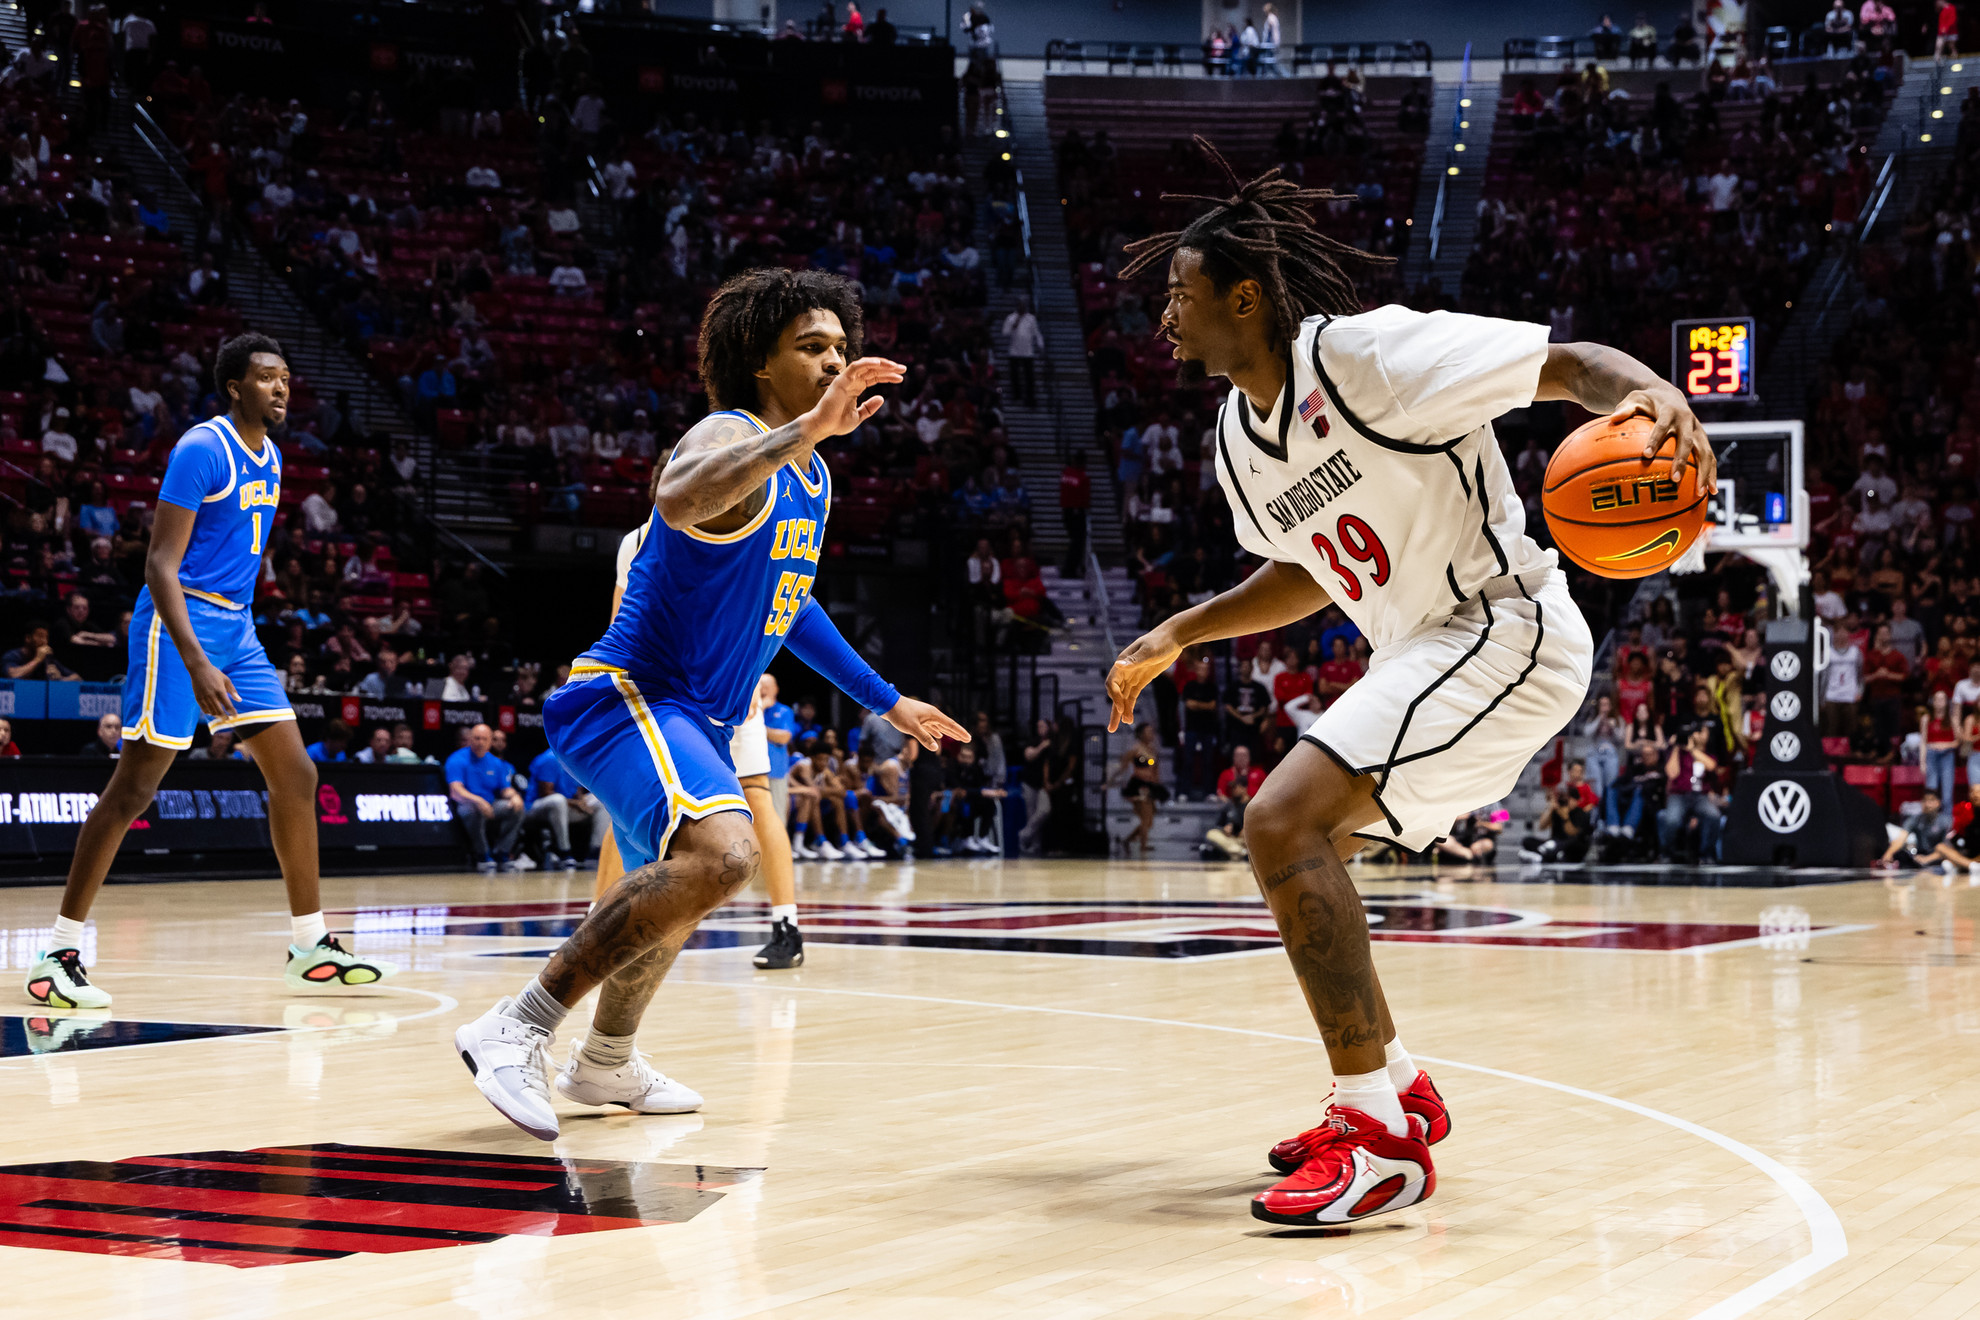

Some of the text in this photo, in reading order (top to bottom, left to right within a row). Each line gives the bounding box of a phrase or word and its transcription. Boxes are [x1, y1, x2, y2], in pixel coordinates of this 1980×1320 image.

[216, 31, 284, 52] TOYOTA
[405, 52, 475, 70] TOYOTA
[672, 74, 738, 92] TOYOTA
[855, 85, 922, 100] TOYOTA
[1690, 325, 1747, 351] 19:22
[1687, 350, 1741, 395] 23
[1266, 448, 1363, 533] SAN DIEGO STATE
[1590, 478, 1679, 512] ELITE
[250, 512, 262, 555] 1
[770, 518, 822, 566] UCL
[1311, 514, 1391, 601] 39
[764, 570, 815, 636] 55
[292, 703, 326, 719] YOTA
[364, 705, 407, 722] TOYOTA
[443, 709, 485, 725] TOYOTA
[517, 712, 544, 728] TOYO
[355, 794, 416, 821] SUPPORT
[1758, 780, 1811, 834] VW
